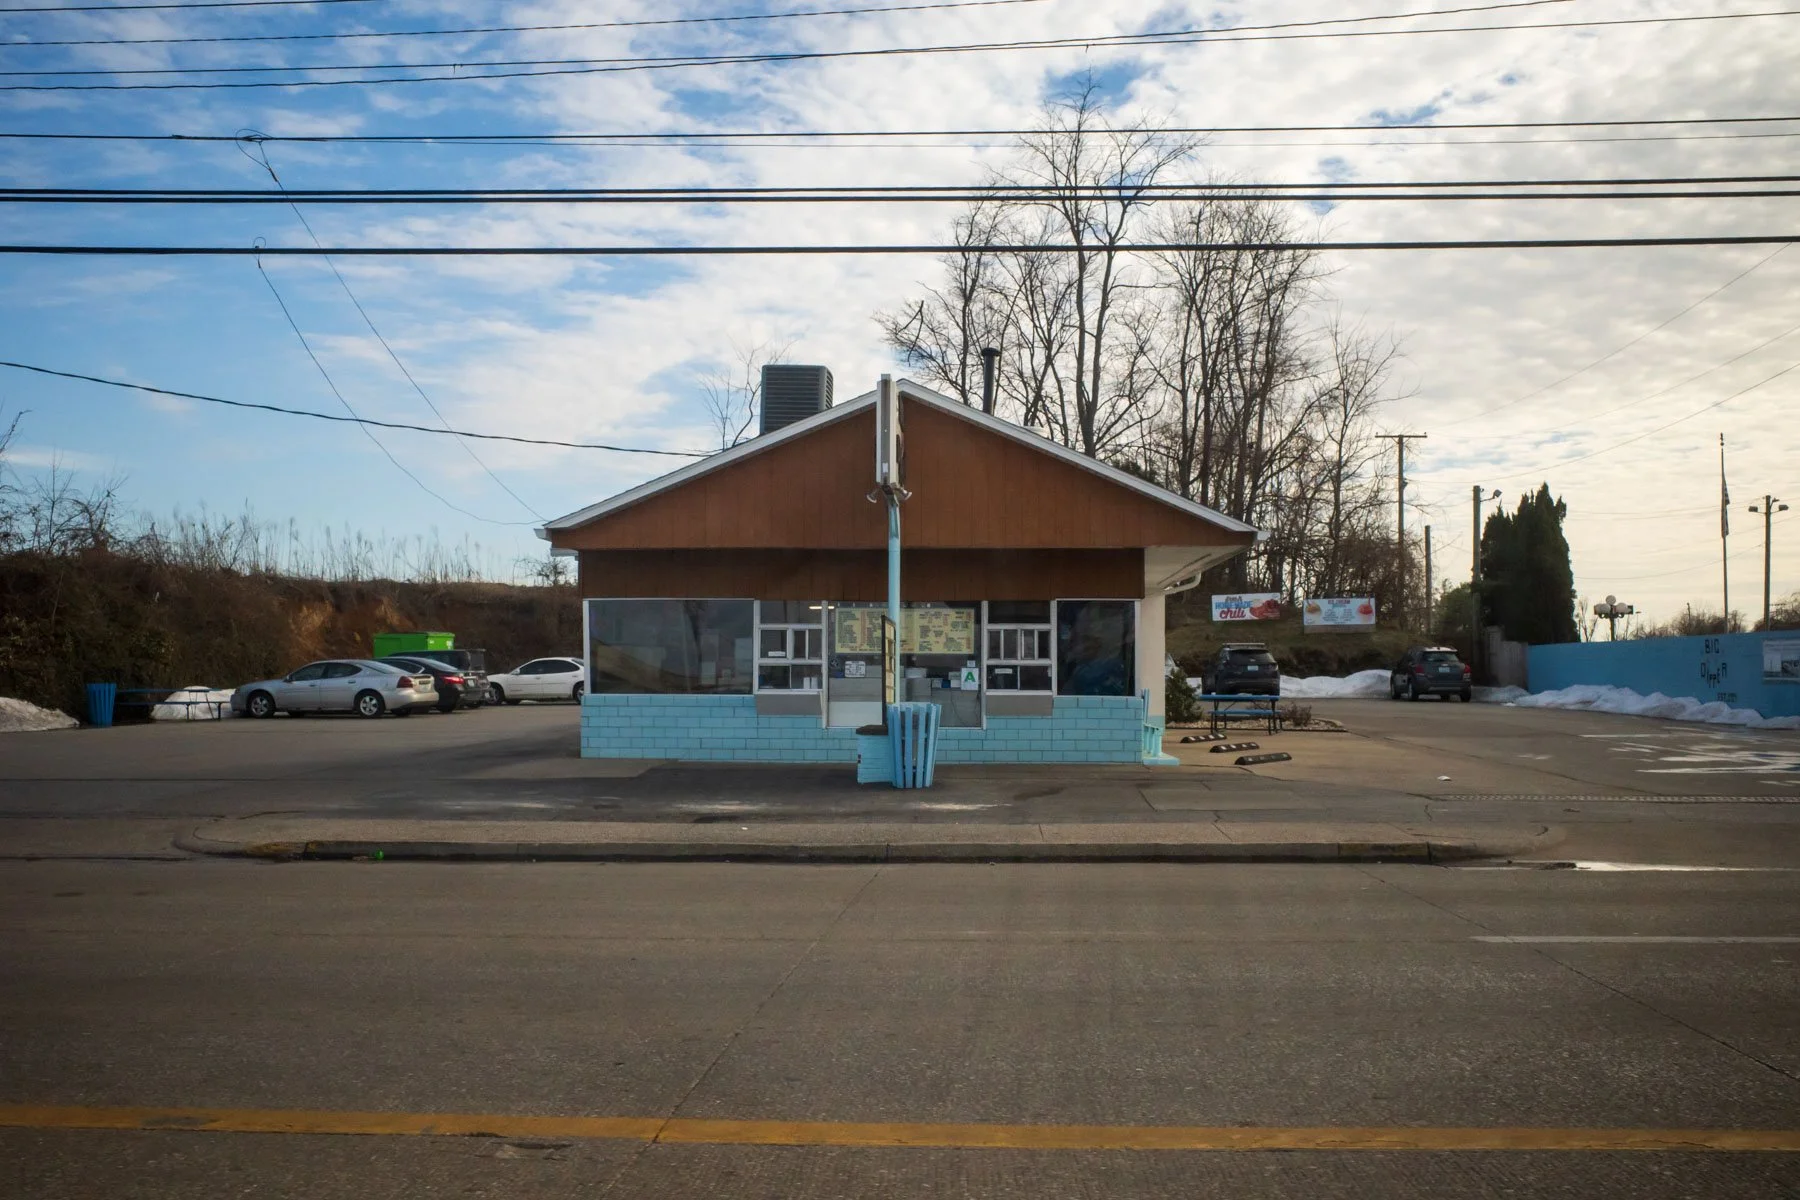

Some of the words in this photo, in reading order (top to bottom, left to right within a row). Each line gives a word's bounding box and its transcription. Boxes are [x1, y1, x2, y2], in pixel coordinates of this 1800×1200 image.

[1219, 608, 1246, 619] chili
[1704, 639, 1720, 654] BIG
[964, 671, 976, 683] A
